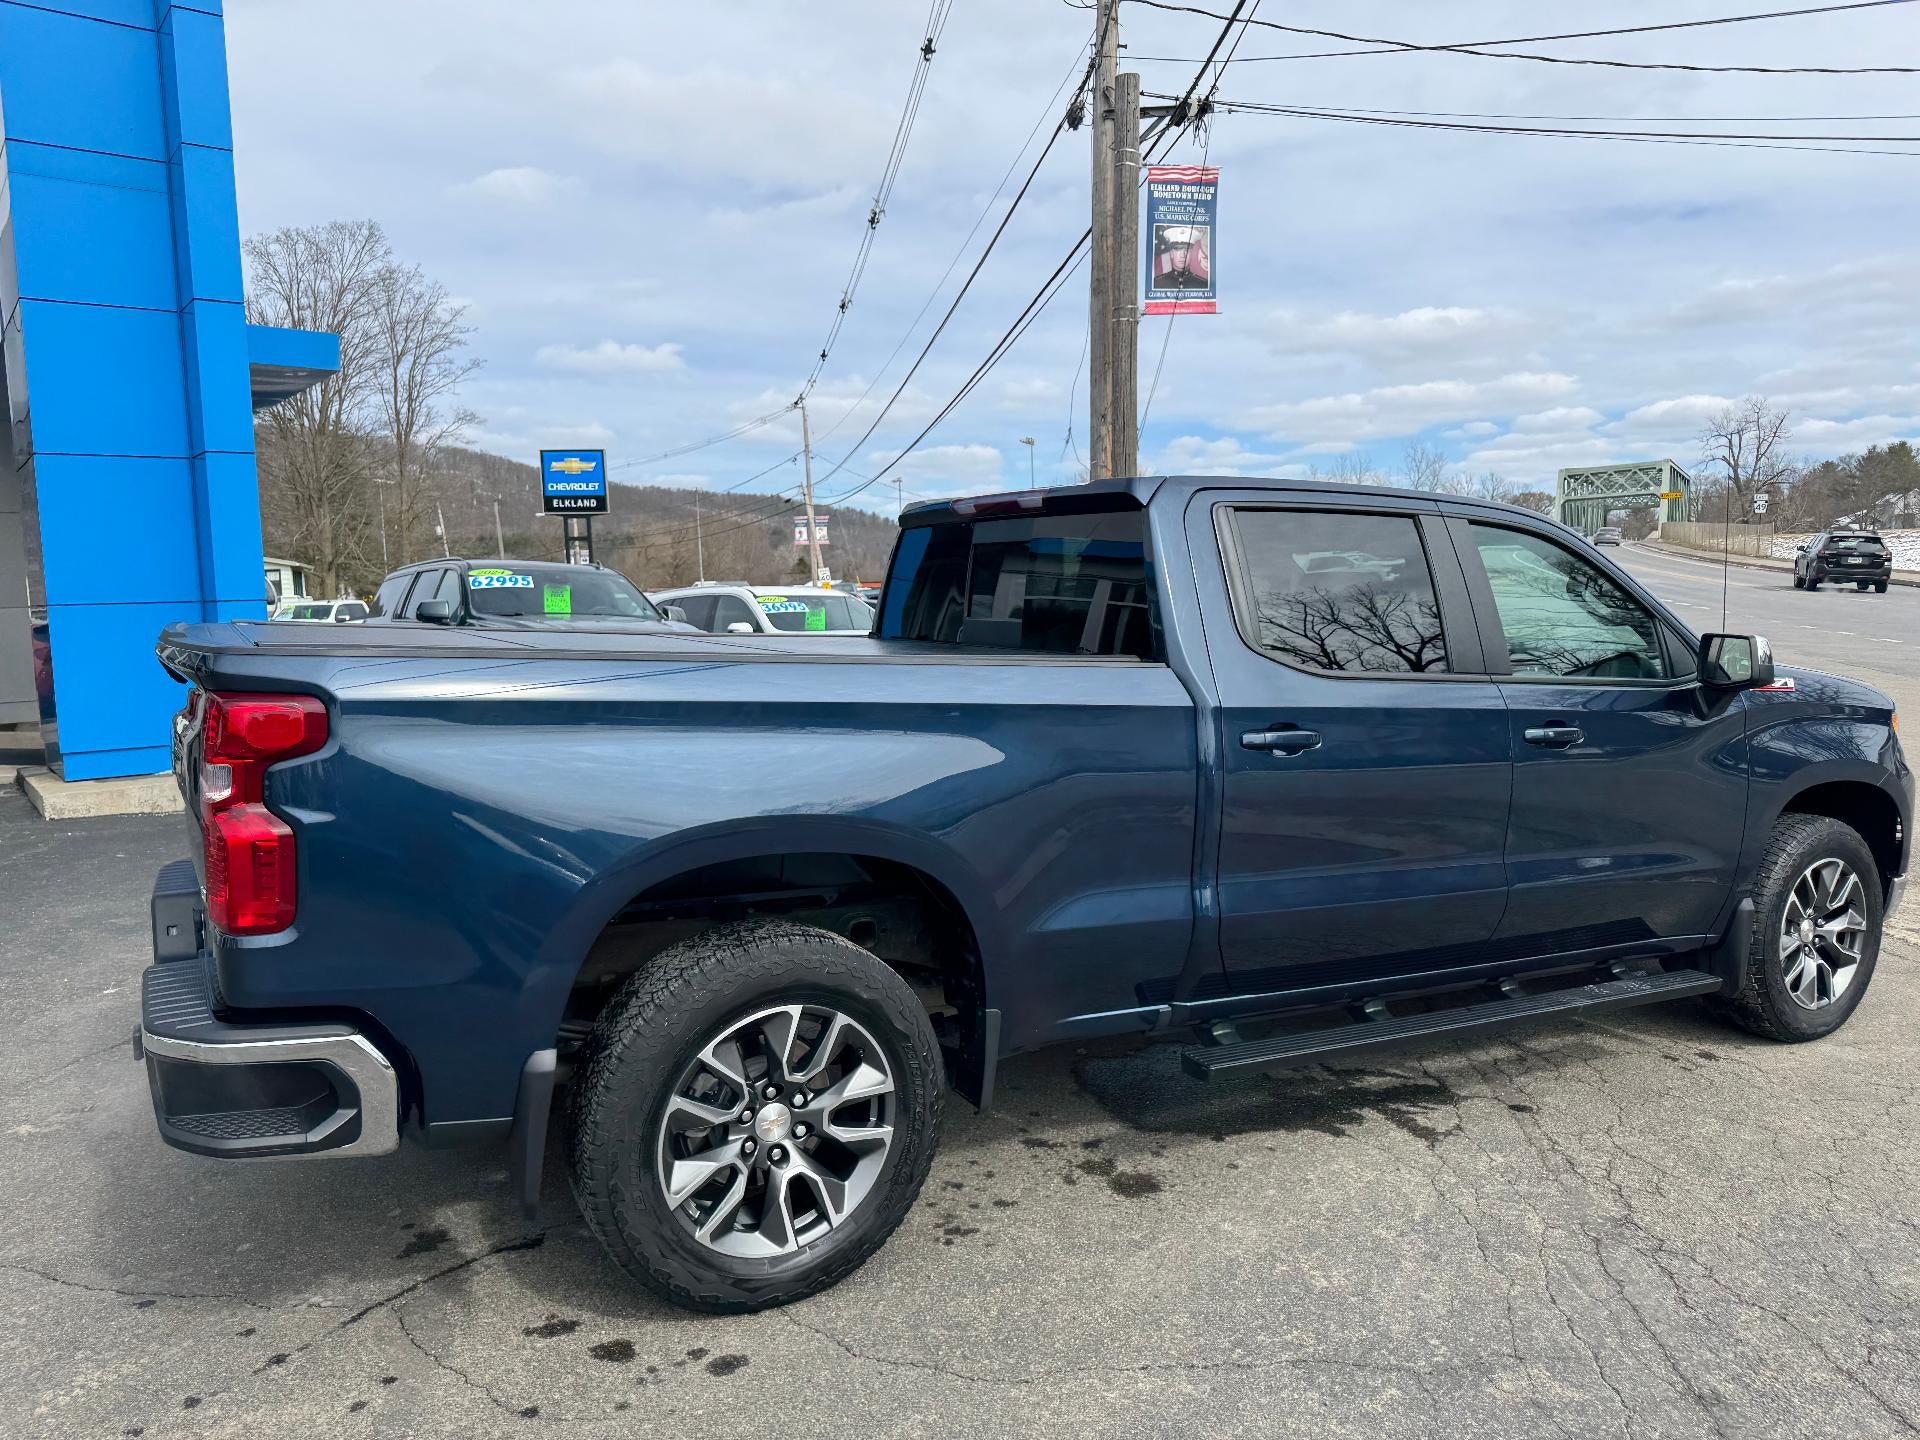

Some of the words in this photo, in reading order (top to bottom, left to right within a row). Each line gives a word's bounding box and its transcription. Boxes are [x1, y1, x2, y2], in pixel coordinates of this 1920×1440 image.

[1151, 184, 1180, 192] ELKLAND
[1182, 185, 1215, 193] BOROUGH
[1153, 191, 1191, 199] HOMETOWN
[553, 499, 596, 507] ELKLAND
[471, 576, 530, 587] 62995
[762, 602, 806, 612] 36995
